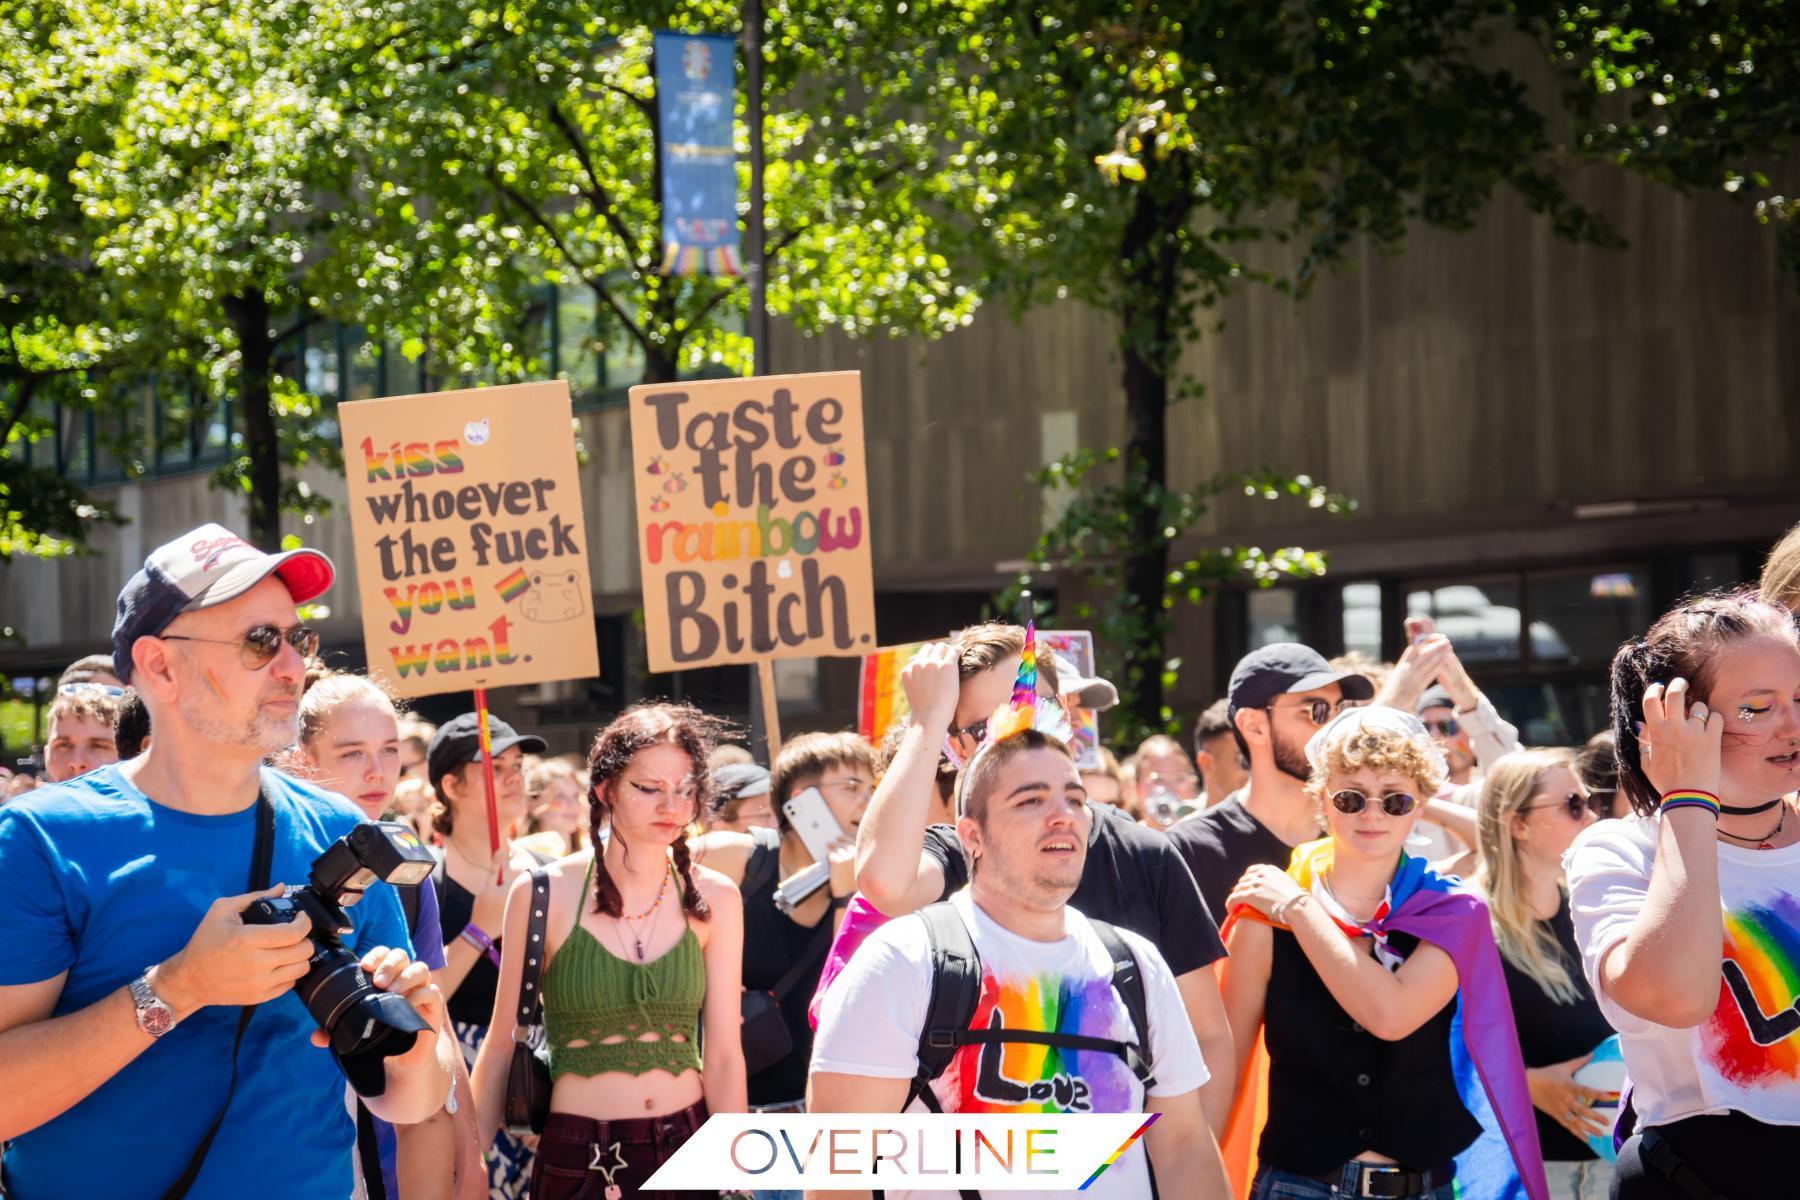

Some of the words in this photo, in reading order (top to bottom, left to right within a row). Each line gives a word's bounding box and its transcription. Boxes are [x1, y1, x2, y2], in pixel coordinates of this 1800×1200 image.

[644, 388, 843, 452] Taste
[360, 436, 465, 483] kiss
[692, 446, 816, 509] the
[365, 477, 556, 525] whoever
[375, 528, 458, 582] the
[470, 514, 580, 567] fuck
[646, 502, 862, 565] rainbow
[382, 576, 476, 636] you
[665, 558, 872, 664] Bitch.
[388, 614, 533, 678] want.
[975, 1005, 1094, 1113] Love
